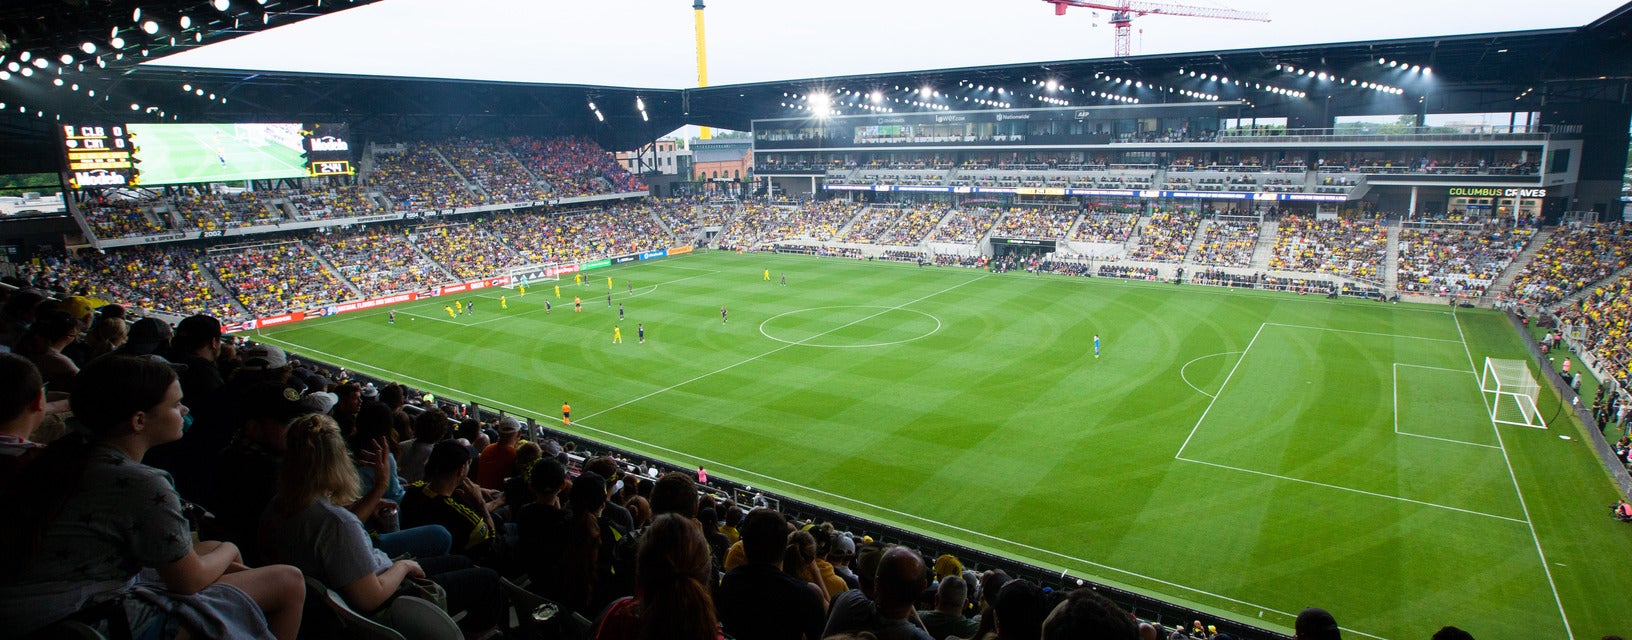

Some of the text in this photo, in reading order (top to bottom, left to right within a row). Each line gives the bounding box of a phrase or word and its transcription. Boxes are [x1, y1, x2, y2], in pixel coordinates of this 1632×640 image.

[81, 126, 123, 137] CLB 0
[115, 138, 125, 148] 0
[310, 138, 349, 152] Modelo
[75, 171, 126, 186] Modelo
[1449, 187, 1503, 196] COLUMBUS
[204, 230, 222, 238] 2002
